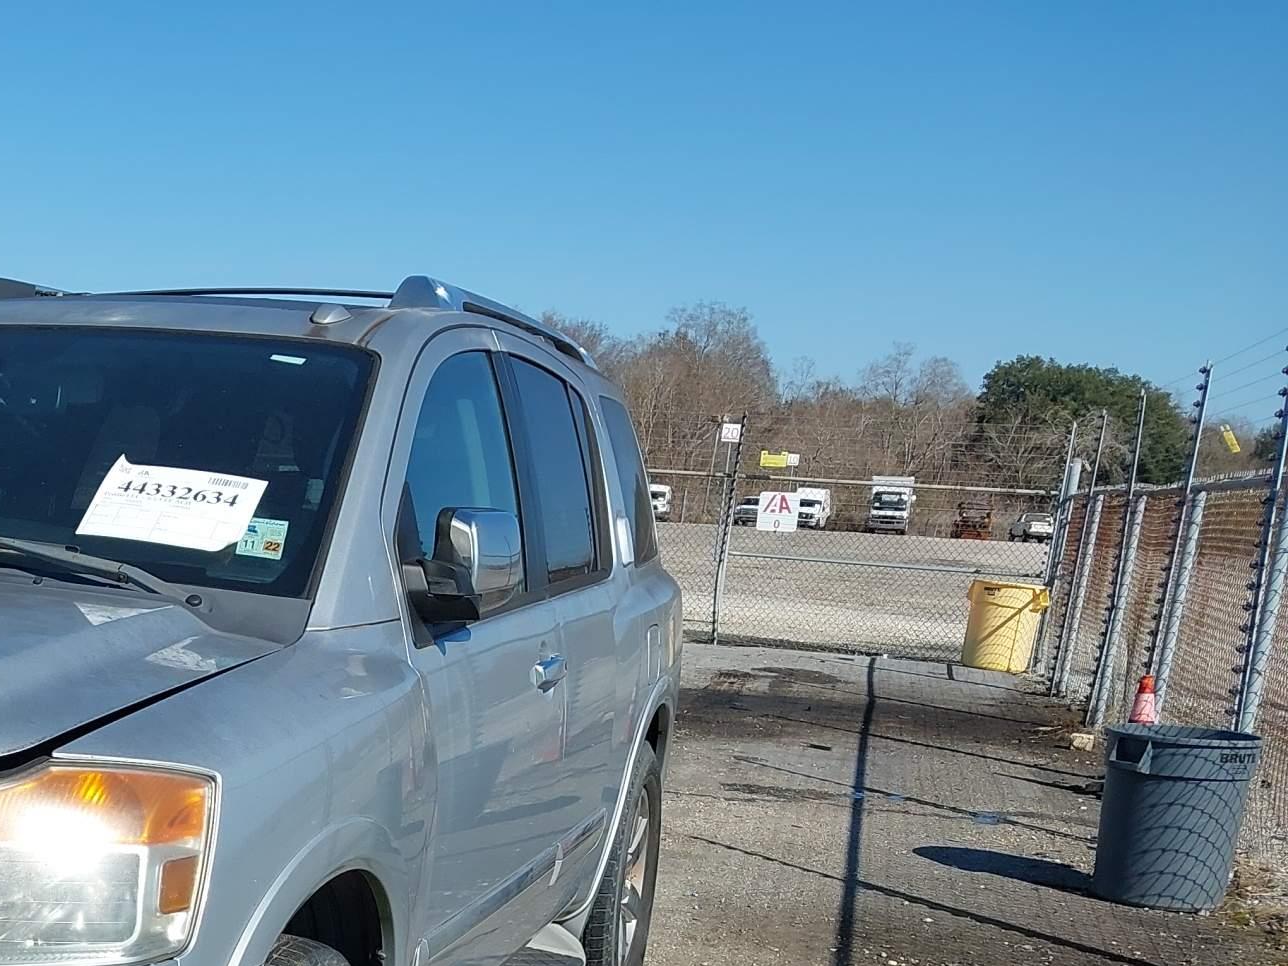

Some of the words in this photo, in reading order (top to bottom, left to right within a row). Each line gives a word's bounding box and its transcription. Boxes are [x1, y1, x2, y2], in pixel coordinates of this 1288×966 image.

[117, 479, 240, 507] 44332634
[241, 539, 255, 551] 11
[264, 540, 281, 552] 22
